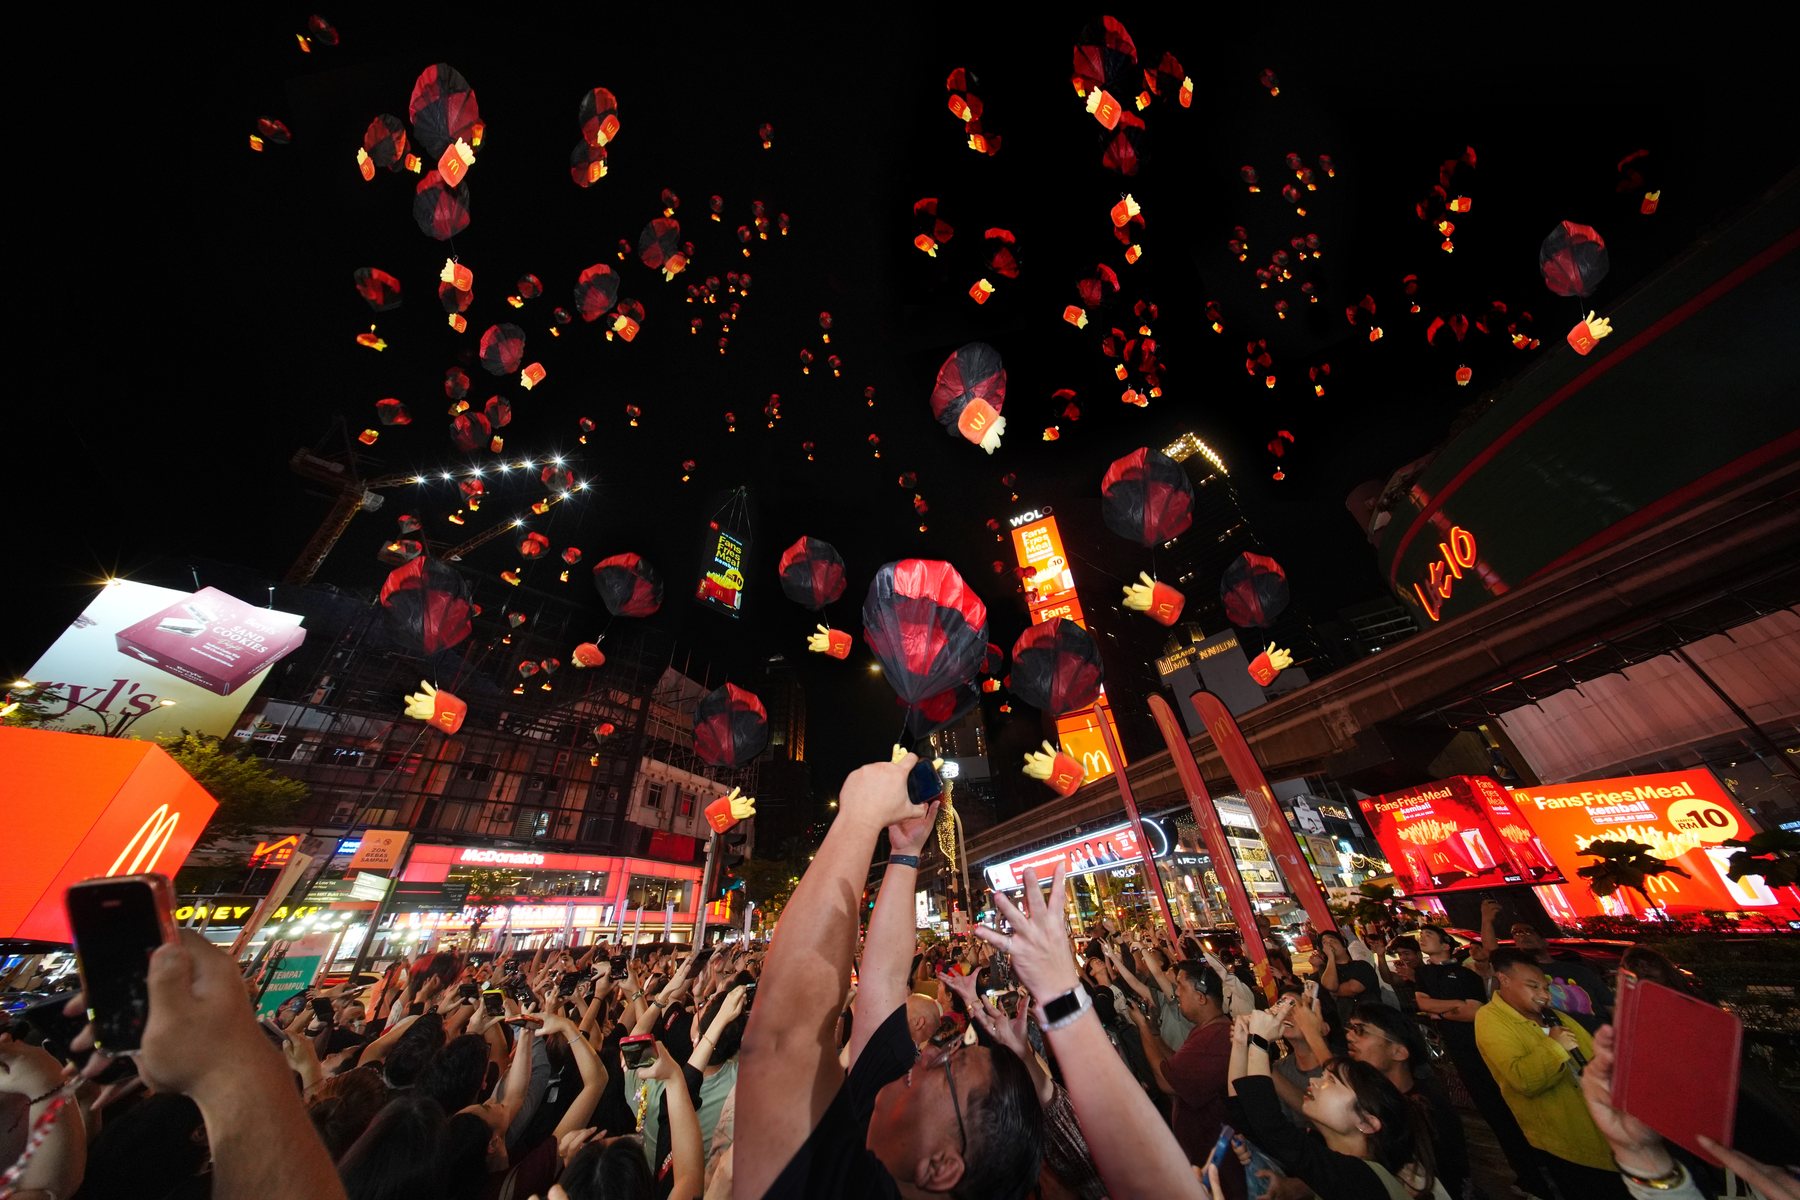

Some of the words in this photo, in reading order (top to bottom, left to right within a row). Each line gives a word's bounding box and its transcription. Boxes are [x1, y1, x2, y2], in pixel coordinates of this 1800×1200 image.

[1010, 506, 1053, 527] WOLO
[1022, 527, 1048, 539] Fans
[1024, 534, 1049, 546] Fries
[717, 543, 740, 561] Fries
[719, 535, 742, 554] Fans
[716, 550, 740, 568] Meal
[1053, 558, 1063, 566] 10
[731, 573, 743, 587] 10
[1041, 605, 1071, 619] Fans
[212, 626, 268, 653] COOKIES
[231, 625, 265, 643] SAND
[1171, 646, 1196, 661] GRAND
[1475, 779, 1494, 789] Fans
[1423, 787, 1453, 802] Meal
[1534, 796, 1584, 810] Fans
[1633, 781, 1695, 800] Meal
[1400, 802, 1432, 814] kembali
[1585, 801, 1650, 815] kembali
[1686, 808, 1729, 828] 10
[1678, 822, 1699, 830] RM
[461, 849, 544, 864] McDonald's
[175, 905, 250, 920] ONEY
[273, 970, 304, 979] TEMPAT
